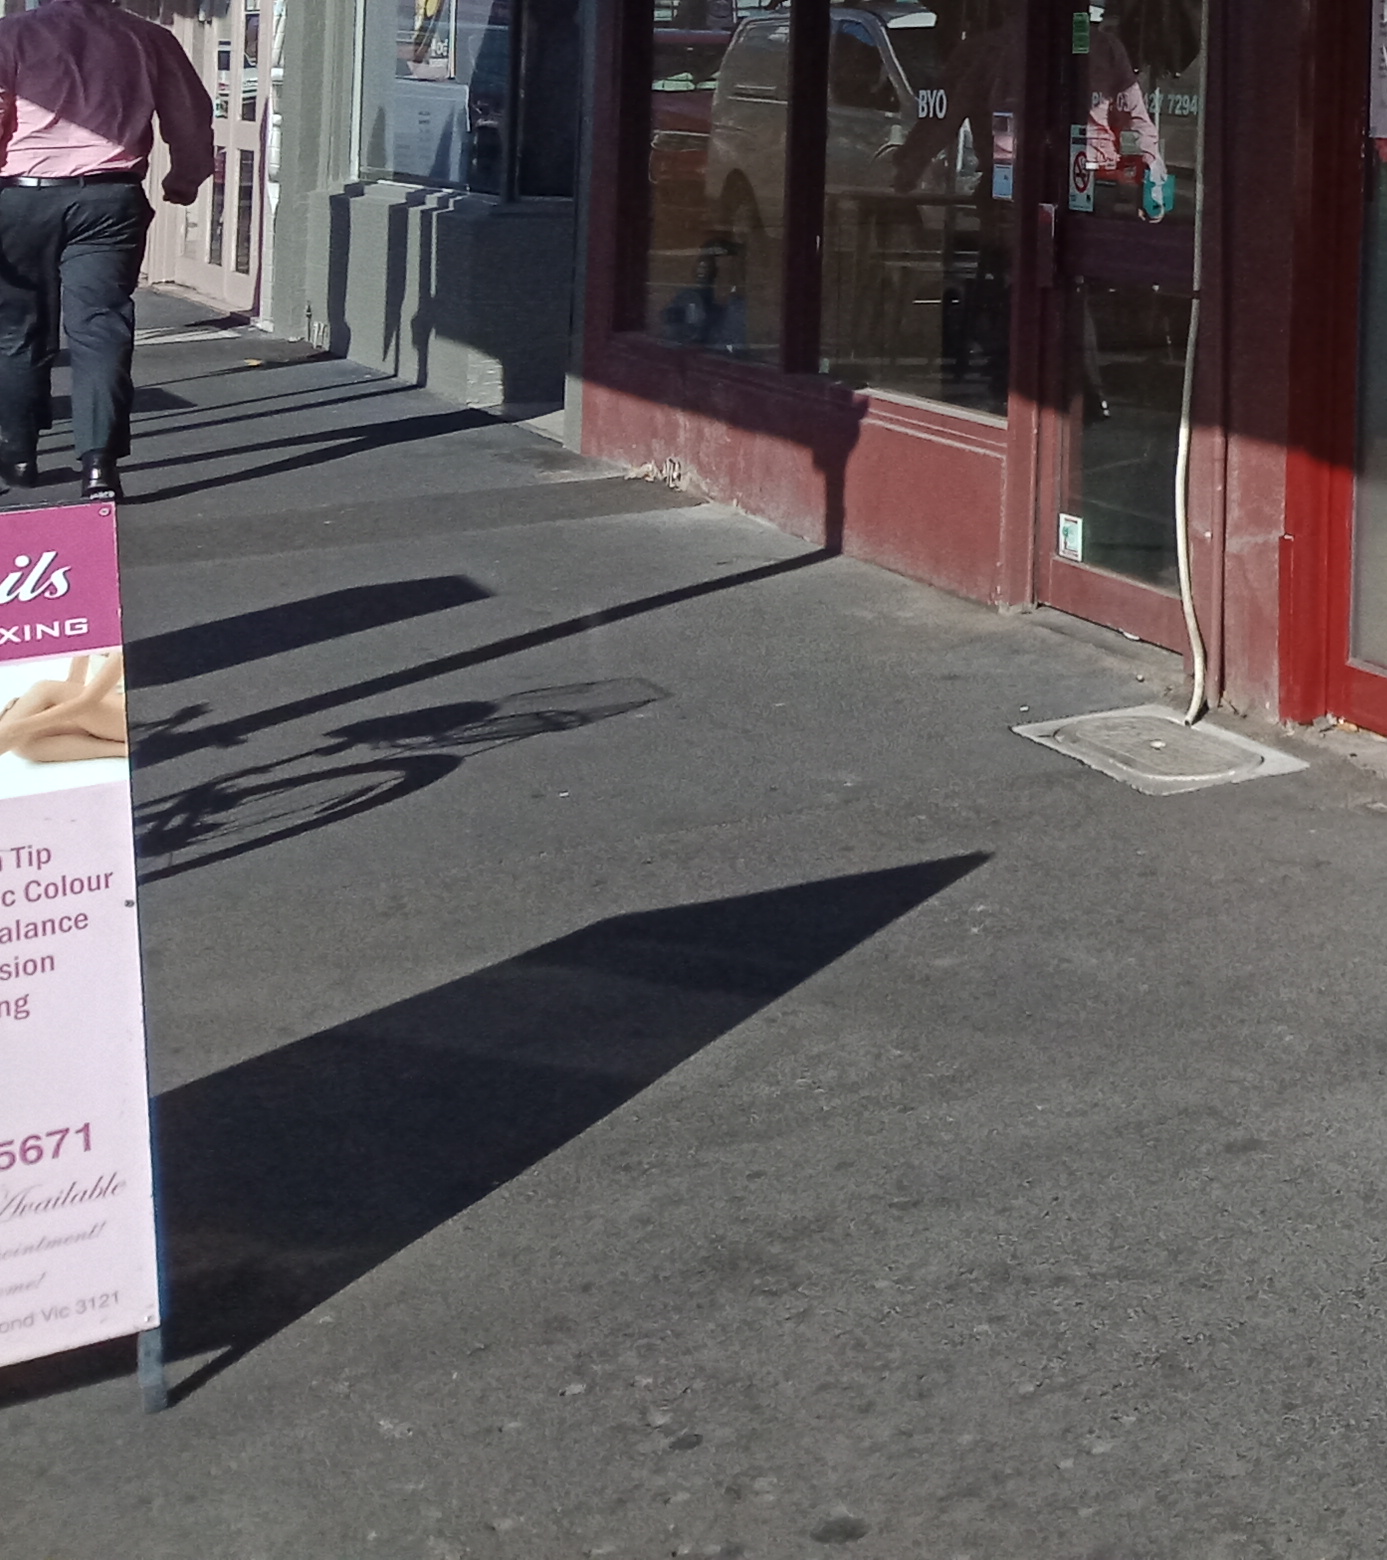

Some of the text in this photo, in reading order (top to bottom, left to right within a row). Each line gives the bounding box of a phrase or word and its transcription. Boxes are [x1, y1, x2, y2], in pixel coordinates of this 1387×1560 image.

[917, 88, 948, 119] BYO
[1168, 94, 1199, 115] 7294
[0, 550, 73, 605] ils
[0, 617, 89, 646] XING
[10, 844, 53, 871] Tip
[24, 872, 114, 903] Colour
[0, 912, 89, 945] alance
[40, 1303, 70, 1323] Vic
[75, 1290, 120, 1315] 3121
